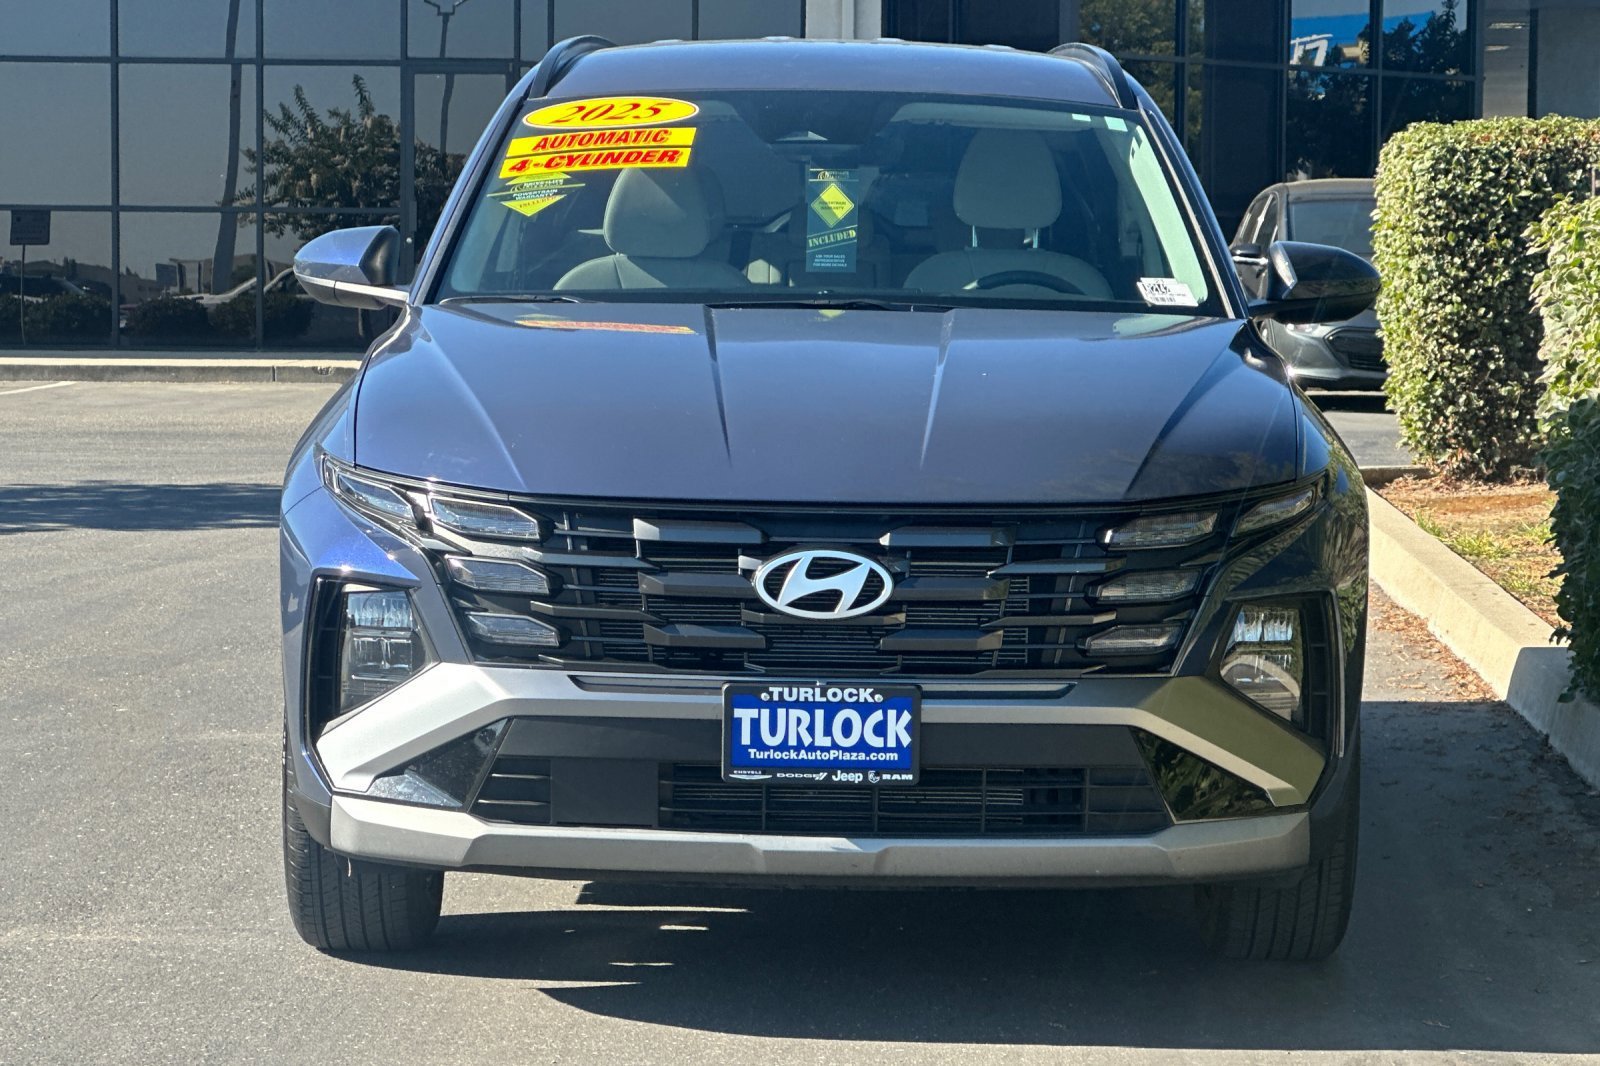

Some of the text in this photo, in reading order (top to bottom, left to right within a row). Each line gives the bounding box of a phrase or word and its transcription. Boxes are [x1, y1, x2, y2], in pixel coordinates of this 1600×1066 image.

[551, 102, 672, 124] 2025
[532, 129, 673, 151] AUTOMATIC
[508, 149, 684, 173] 4-CYLINDER
[512, 188, 558, 197] POWERTRAIN
[808, 229, 857, 248] INCLUDED
[769, 687, 875, 703] TURLOCK
[733, 707, 912, 748] TURLOCK
[748, 748, 899, 761] TurlockAutoPlaza.com
[831, 770, 864, 784] Jeep
